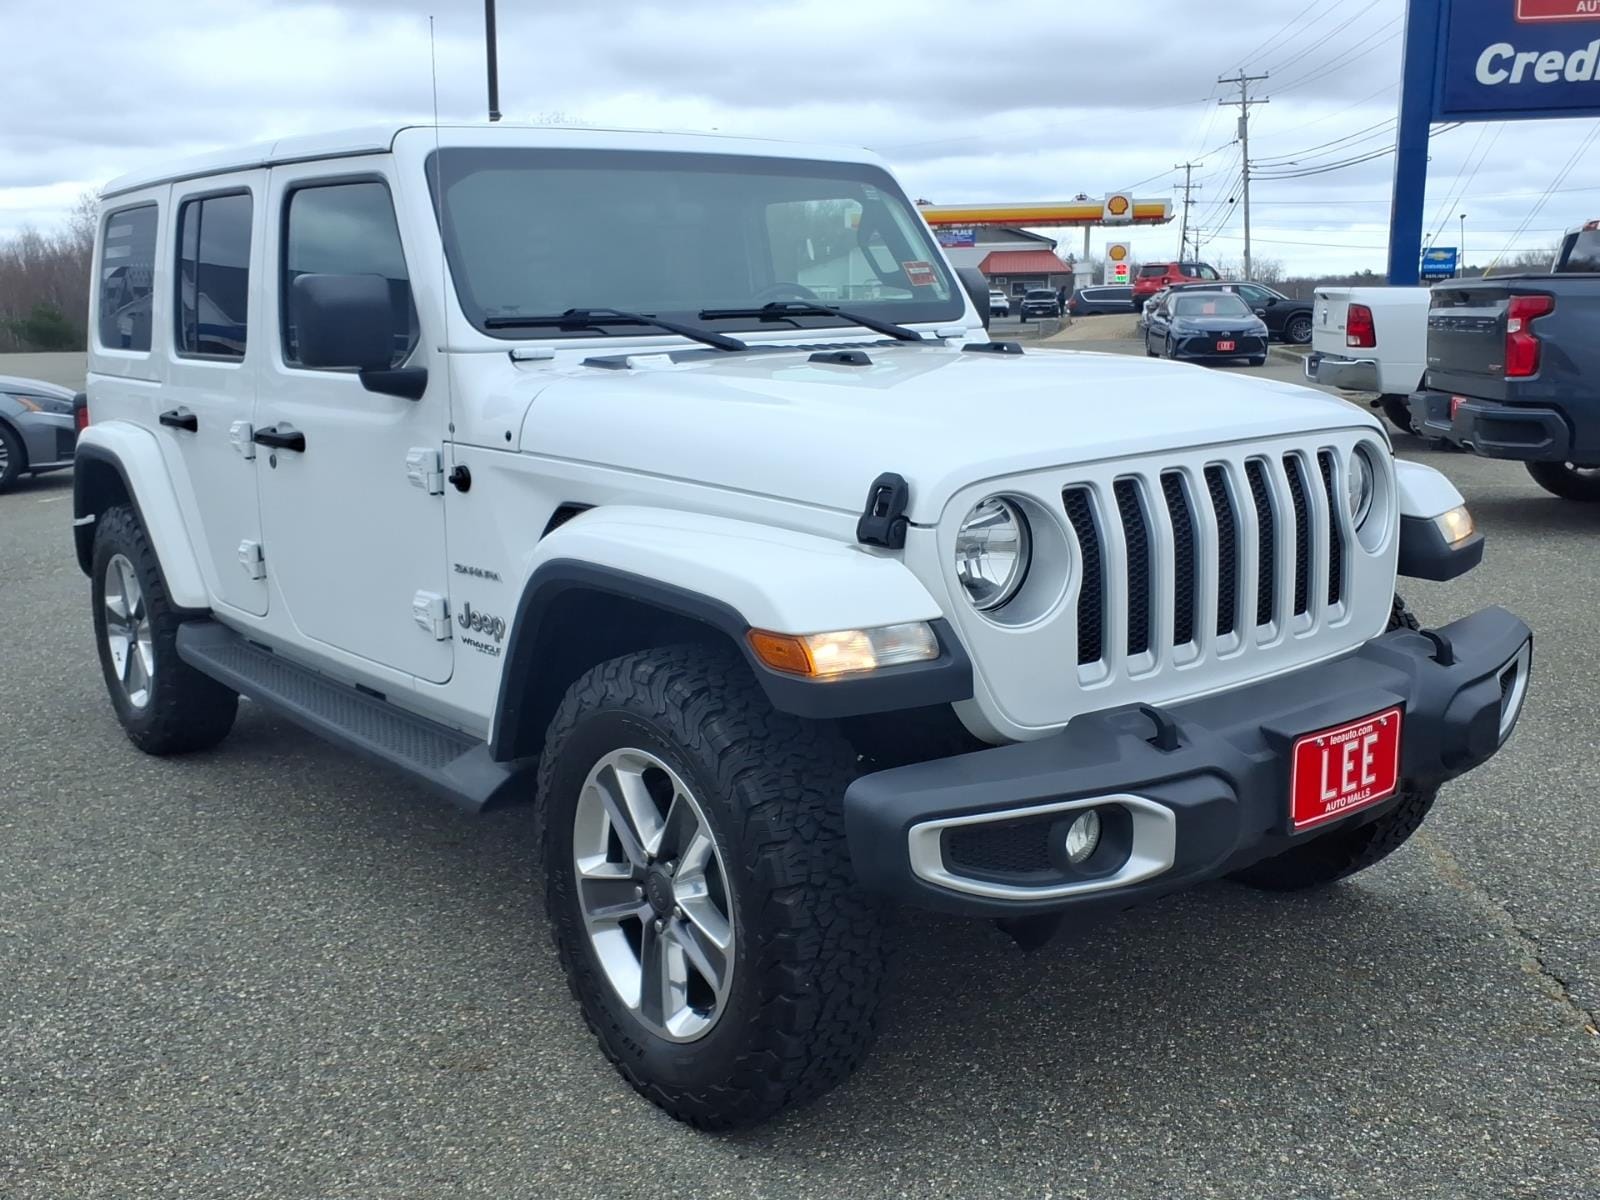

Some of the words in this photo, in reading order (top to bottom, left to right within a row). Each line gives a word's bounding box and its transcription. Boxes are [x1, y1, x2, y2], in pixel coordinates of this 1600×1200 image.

[1575, 0, 1600, 13] AU
[458, 600, 506, 643] Jeep
[1329, 724, 1374, 746] leeauto.com
[1320, 731, 1379, 803] LEE
[1324, 796, 1347, 812] AUTO
[1347, 786, 1371, 805] MALLS
